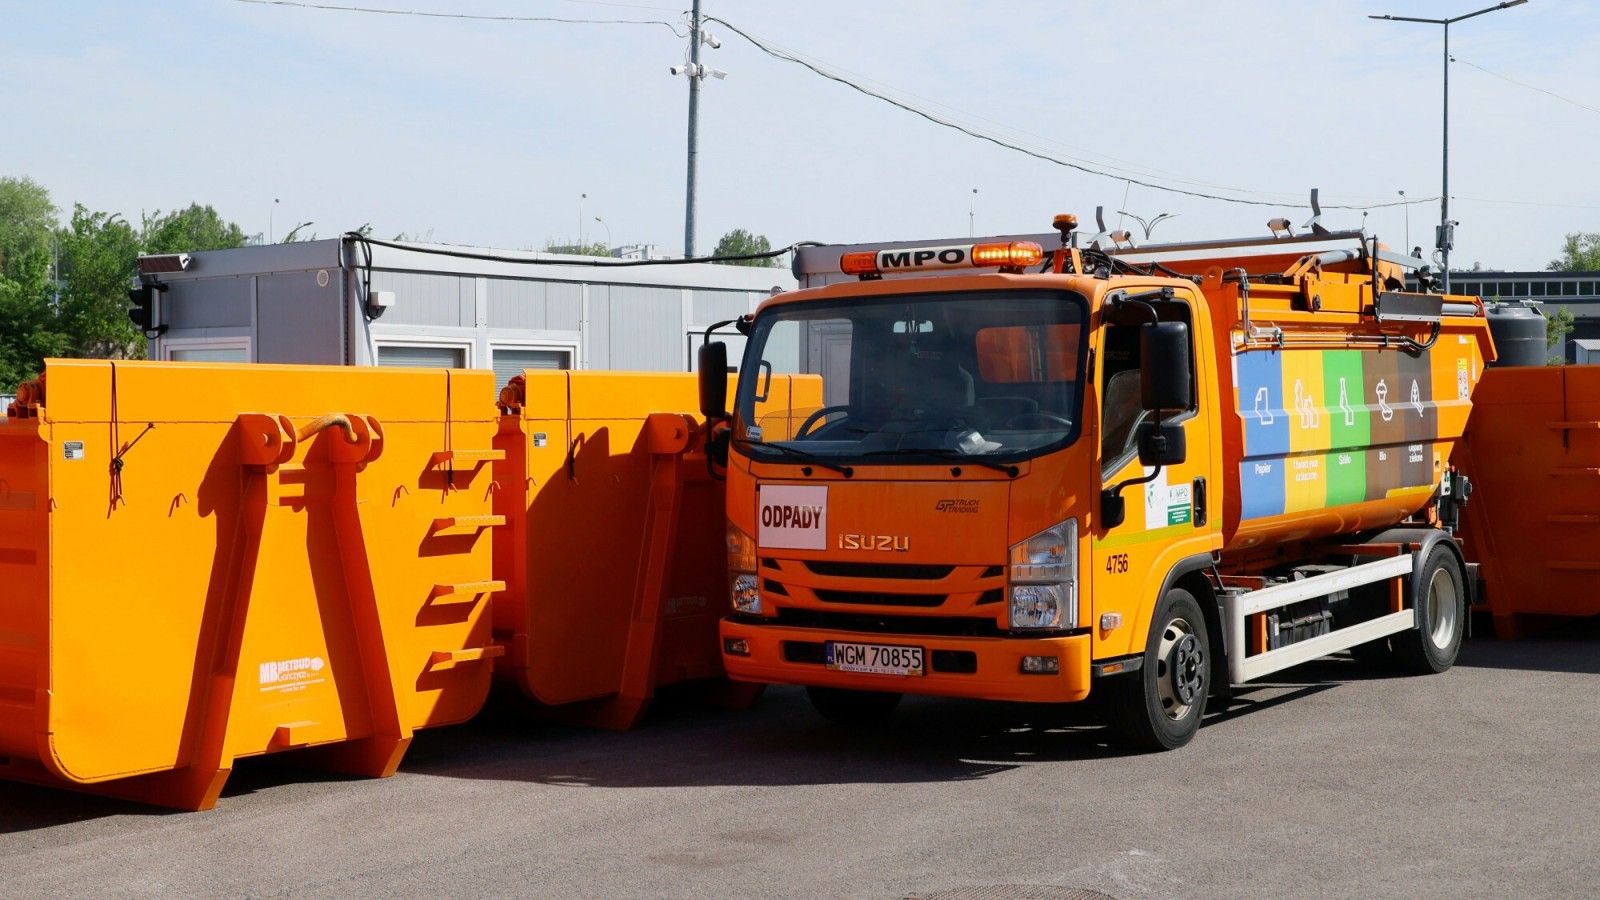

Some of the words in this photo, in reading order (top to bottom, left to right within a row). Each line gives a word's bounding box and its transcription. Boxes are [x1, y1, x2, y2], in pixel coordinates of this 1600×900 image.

[882, 249, 965, 268] MPO
[1255, 464, 1272, 476] Papier
[1175, 487, 1189, 498] MPO
[948, 506, 979, 514] TRADING
[954, 498, 979, 506] TRUCK
[761, 505, 823, 530] ODPADY
[838, 534, 909, 552] ISUZU
[1106, 553, 1129, 575] 4756
[835, 645, 866, 665] WGM
[871, 647, 921, 669] 70855
